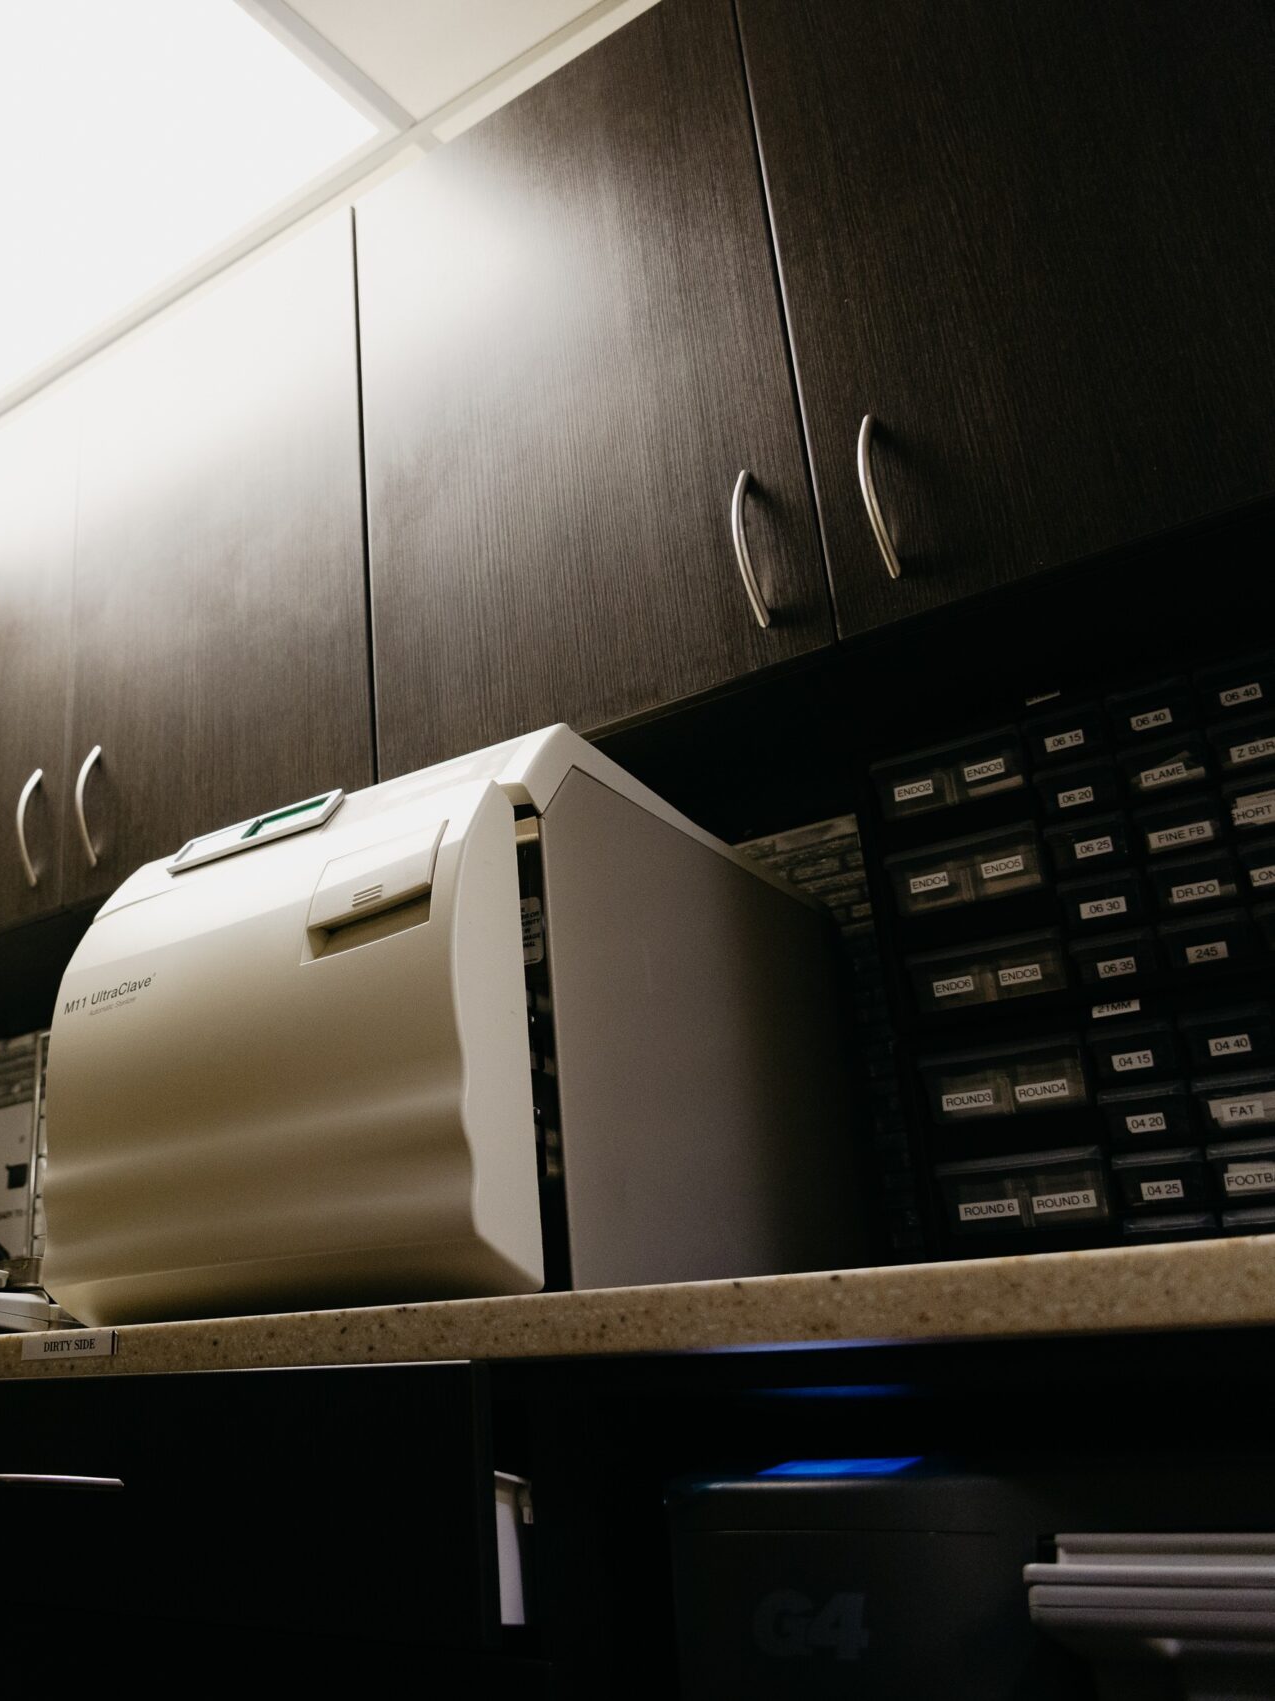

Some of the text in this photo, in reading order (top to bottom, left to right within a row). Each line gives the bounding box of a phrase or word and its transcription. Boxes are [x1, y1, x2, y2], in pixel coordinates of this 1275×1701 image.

[1242, 687, 1258, 699] 40
[1152, 712, 1166, 725] 40
[1069, 733, 1081, 744] 15
[1236, 748, 1246, 759] Z
[967, 762, 1003, 779] ENDO3
[1144, 765, 1183, 783] FLAME
[897, 782, 932, 798] ENDO2
[1078, 789, 1091, 801] 20
[1157, 825, 1205, 844] FINE FB
[1096, 840, 1110, 852] 25
[984, 858, 1022, 875] ENDO5
[912, 875, 948, 891] ENDO4
[1105, 900, 1121, 912] 30
[1194, 946, 1218, 960] 245
[1119, 960, 1134, 972] 35
[1001, 968, 1040, 983] ENDO8
[935, 979, 971, 994] ENDO6
[64, 977, 152, 1015] M11 UltraClave
[1231, 1037, 1248, 1050] 40
[1136, 1053, 1150, 1065] 15
[1018, 1083, 1067, 1099] ROUND4
[945, 1093, 992, 1108] ROUND3
[1229, 1104, 1255, 1117] FAT
[1148, 1116, 1163, 1127] 20
[1226, 1172, 1275, 1188] FOOTB
[1165, 1183, 1180, 1195] 25
[1036, 1194, 1090, 1209] ROUND 8
[964, 1203, 1015, 1217] ROUND 6
[44, 1338, 95, 1352] DIRTY SIDE
[753, 1588, 869, 1662] G4
